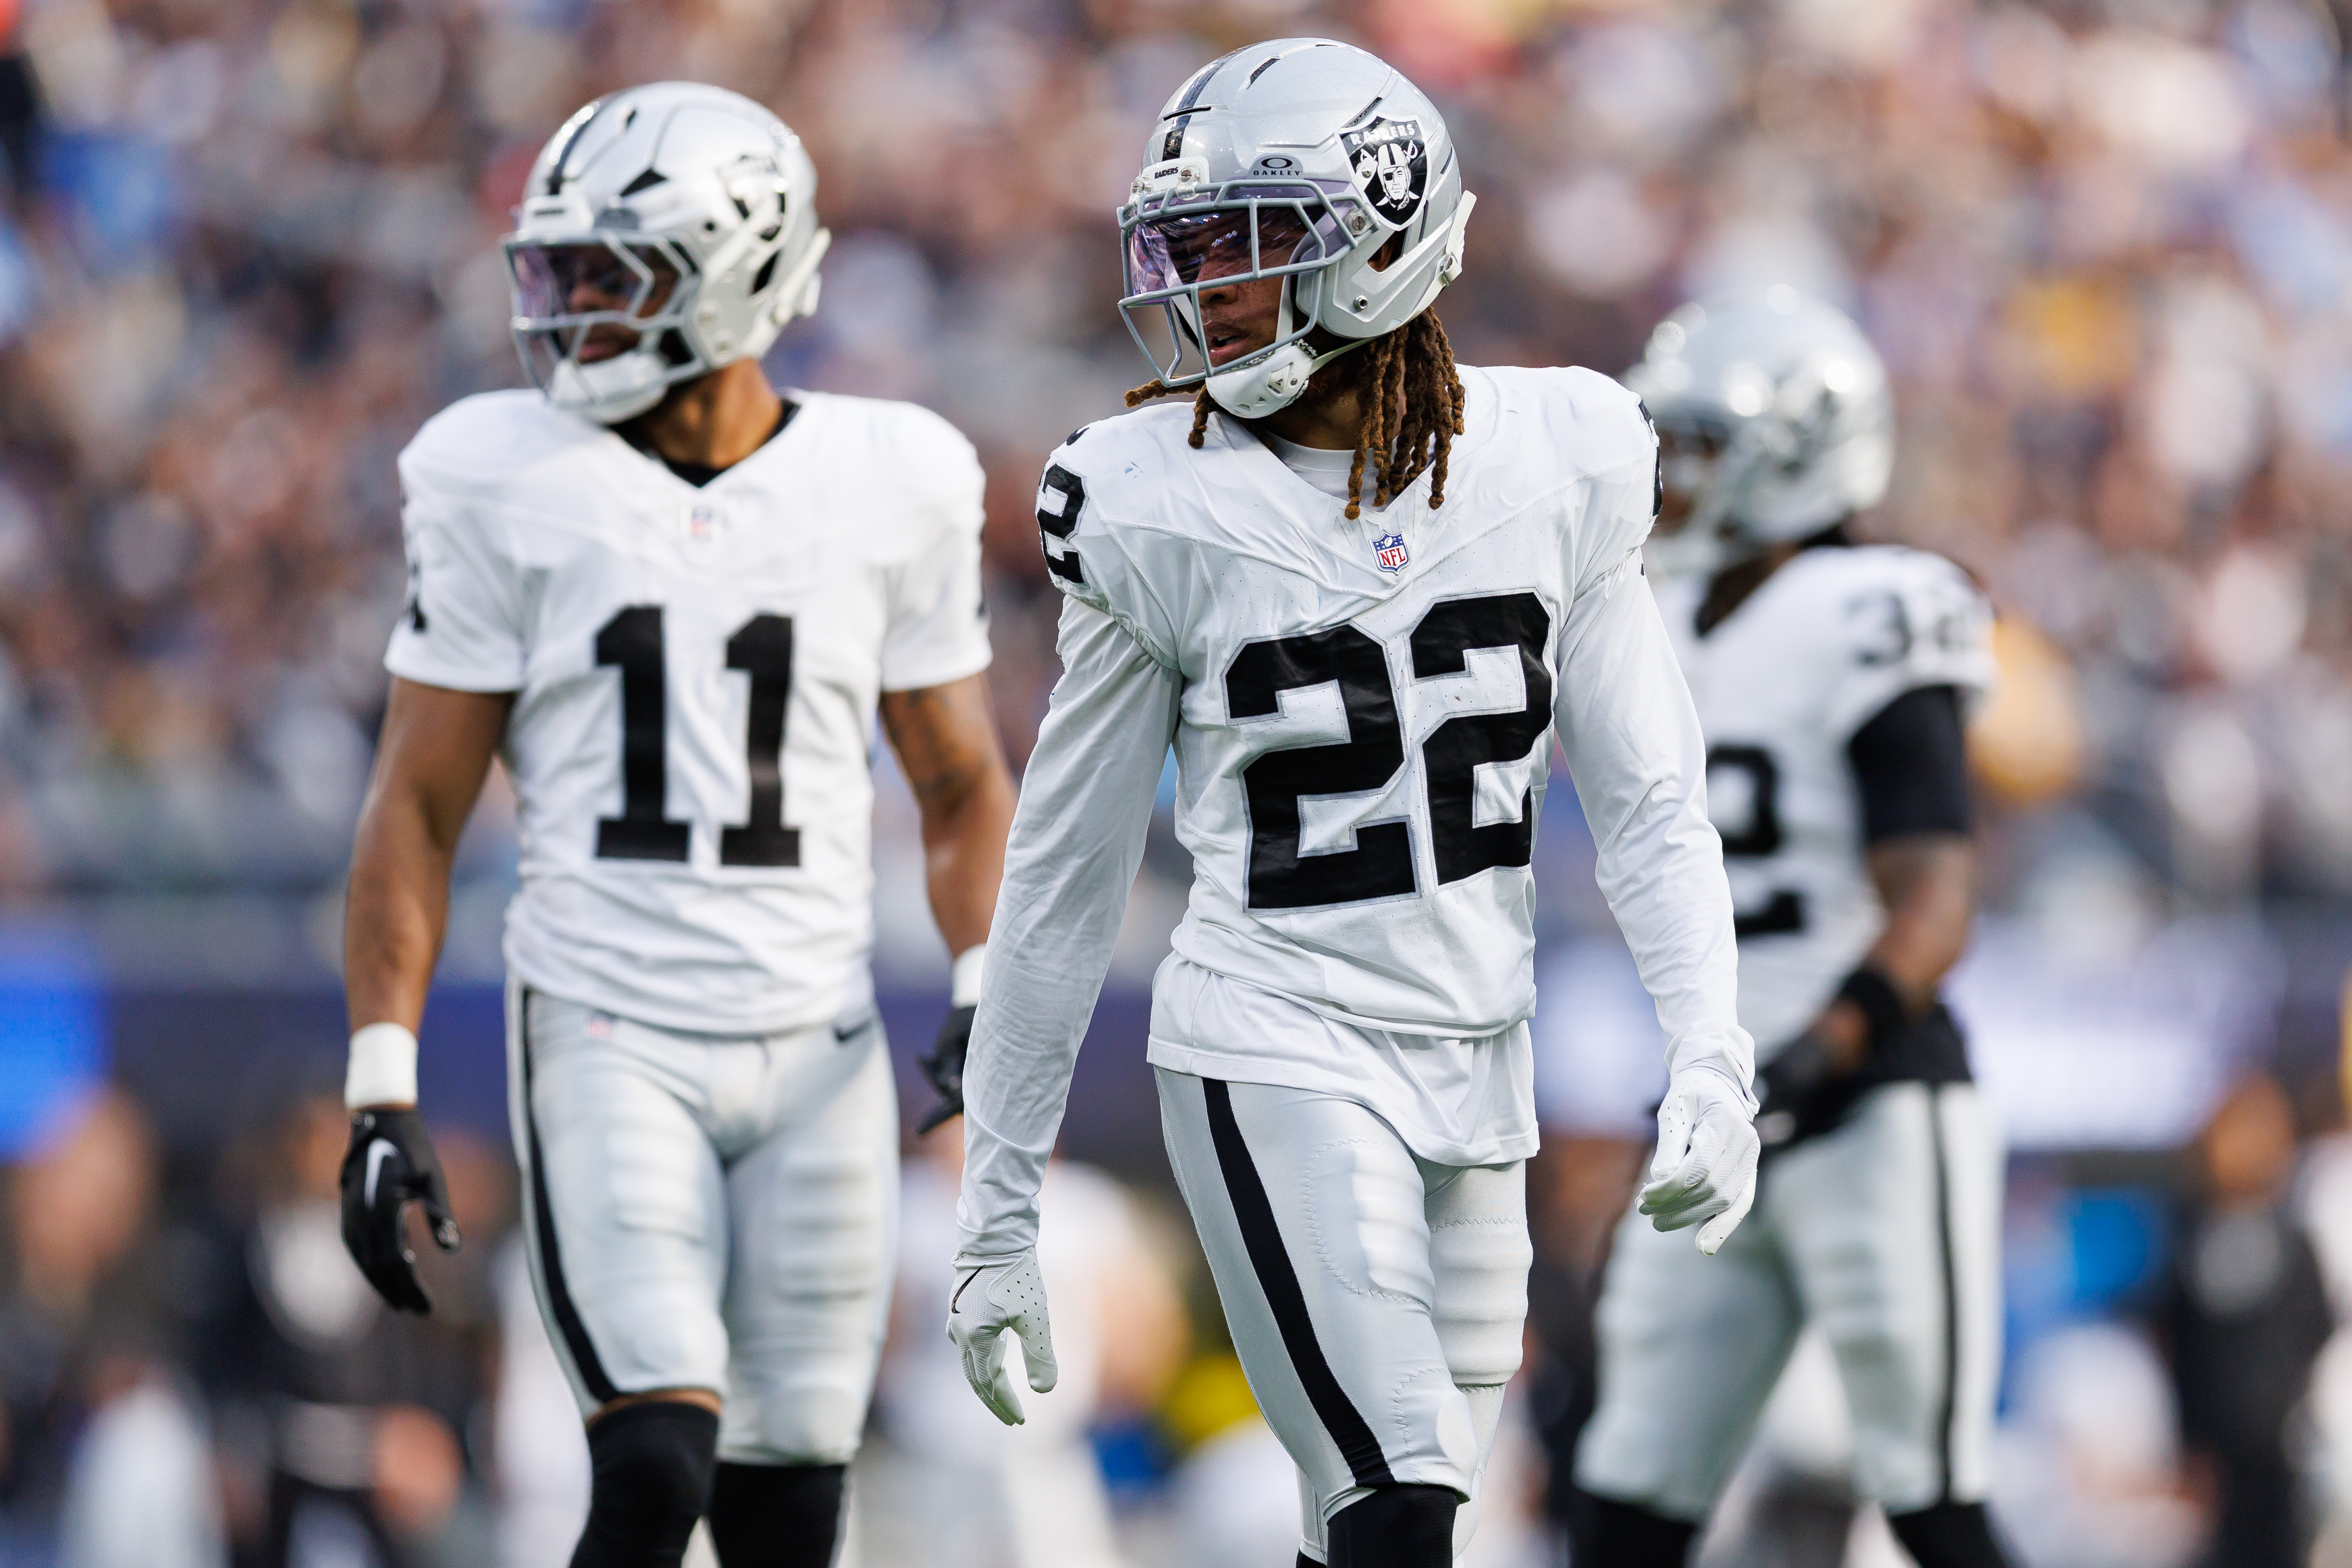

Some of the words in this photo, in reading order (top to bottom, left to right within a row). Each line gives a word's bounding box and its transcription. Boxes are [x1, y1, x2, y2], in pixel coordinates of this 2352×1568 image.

[1154, 167, 1178, 179] RAIDERS
[1379, 548, 1406, 566] NFL
[595, 605, 802, 868] 11
[1223, 589, 1553, 912] 22
